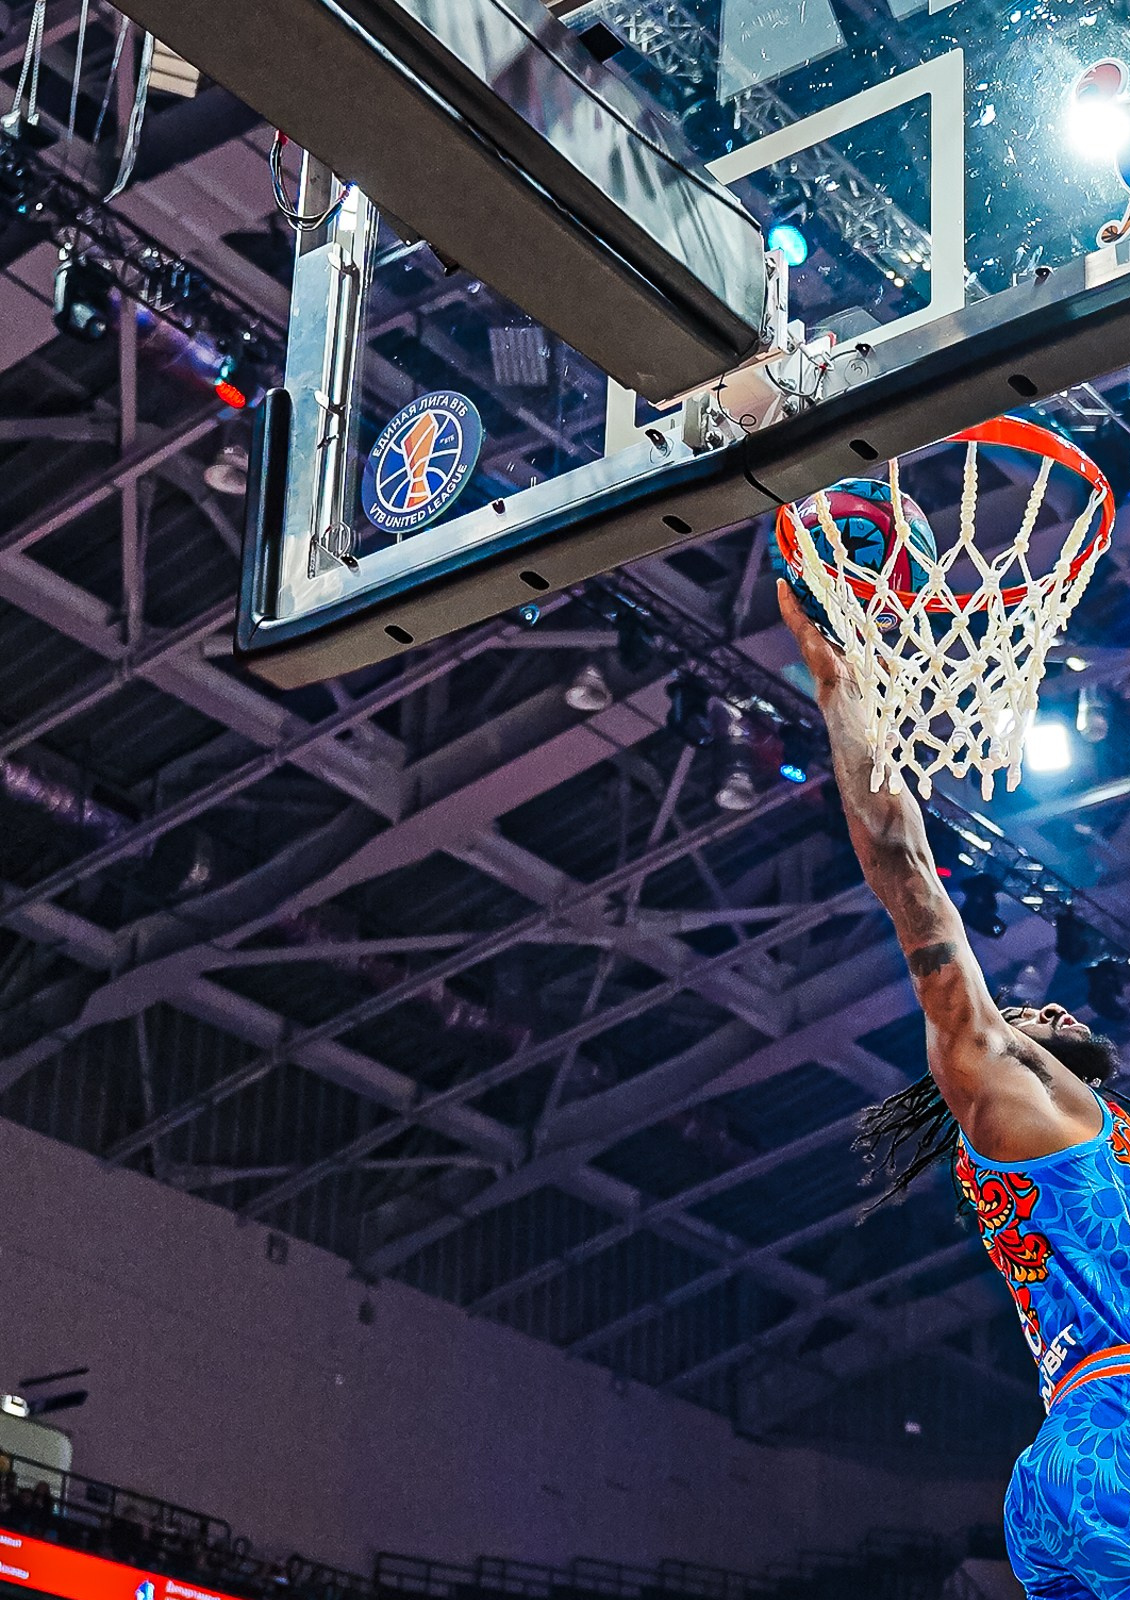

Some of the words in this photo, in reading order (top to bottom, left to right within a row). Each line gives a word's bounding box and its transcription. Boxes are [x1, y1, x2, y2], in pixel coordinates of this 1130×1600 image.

[372, 405, 416, 457] ЕДИНАЯ
[419, 395, 449, 411] ЛИГА
[450, 398, 468, 417] ВТБ
[370, 503, 385, 522] VTB
[385, 510, 426, 527] UNITED
[428, 464, 467, 514] LEAGUE
